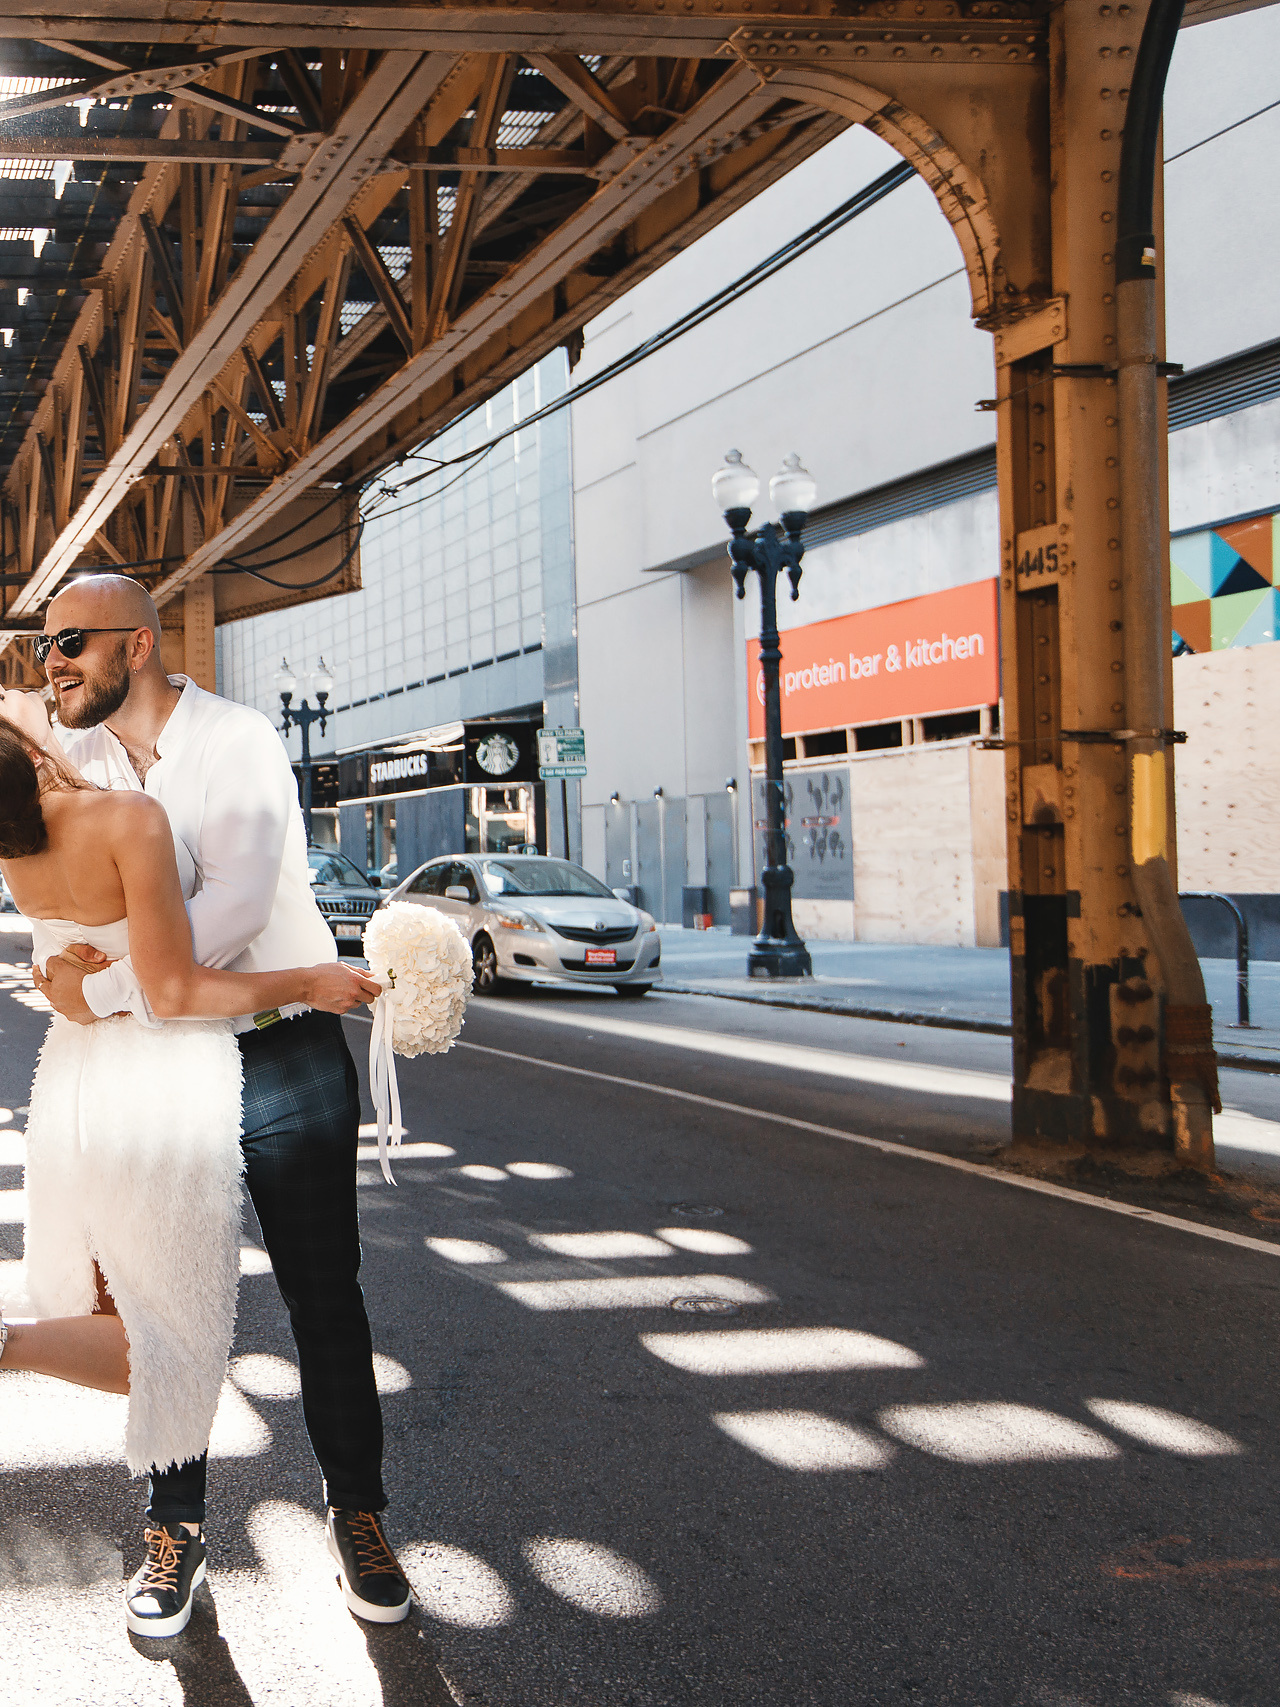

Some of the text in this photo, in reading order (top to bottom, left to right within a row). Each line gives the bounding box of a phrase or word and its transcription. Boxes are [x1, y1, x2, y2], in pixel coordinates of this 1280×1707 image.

[1017, 543, 1058, 577] 445
[784, 632, 984, 697] protein bar & kitchen
[370, 753, 428, 784] STARBUCKS
